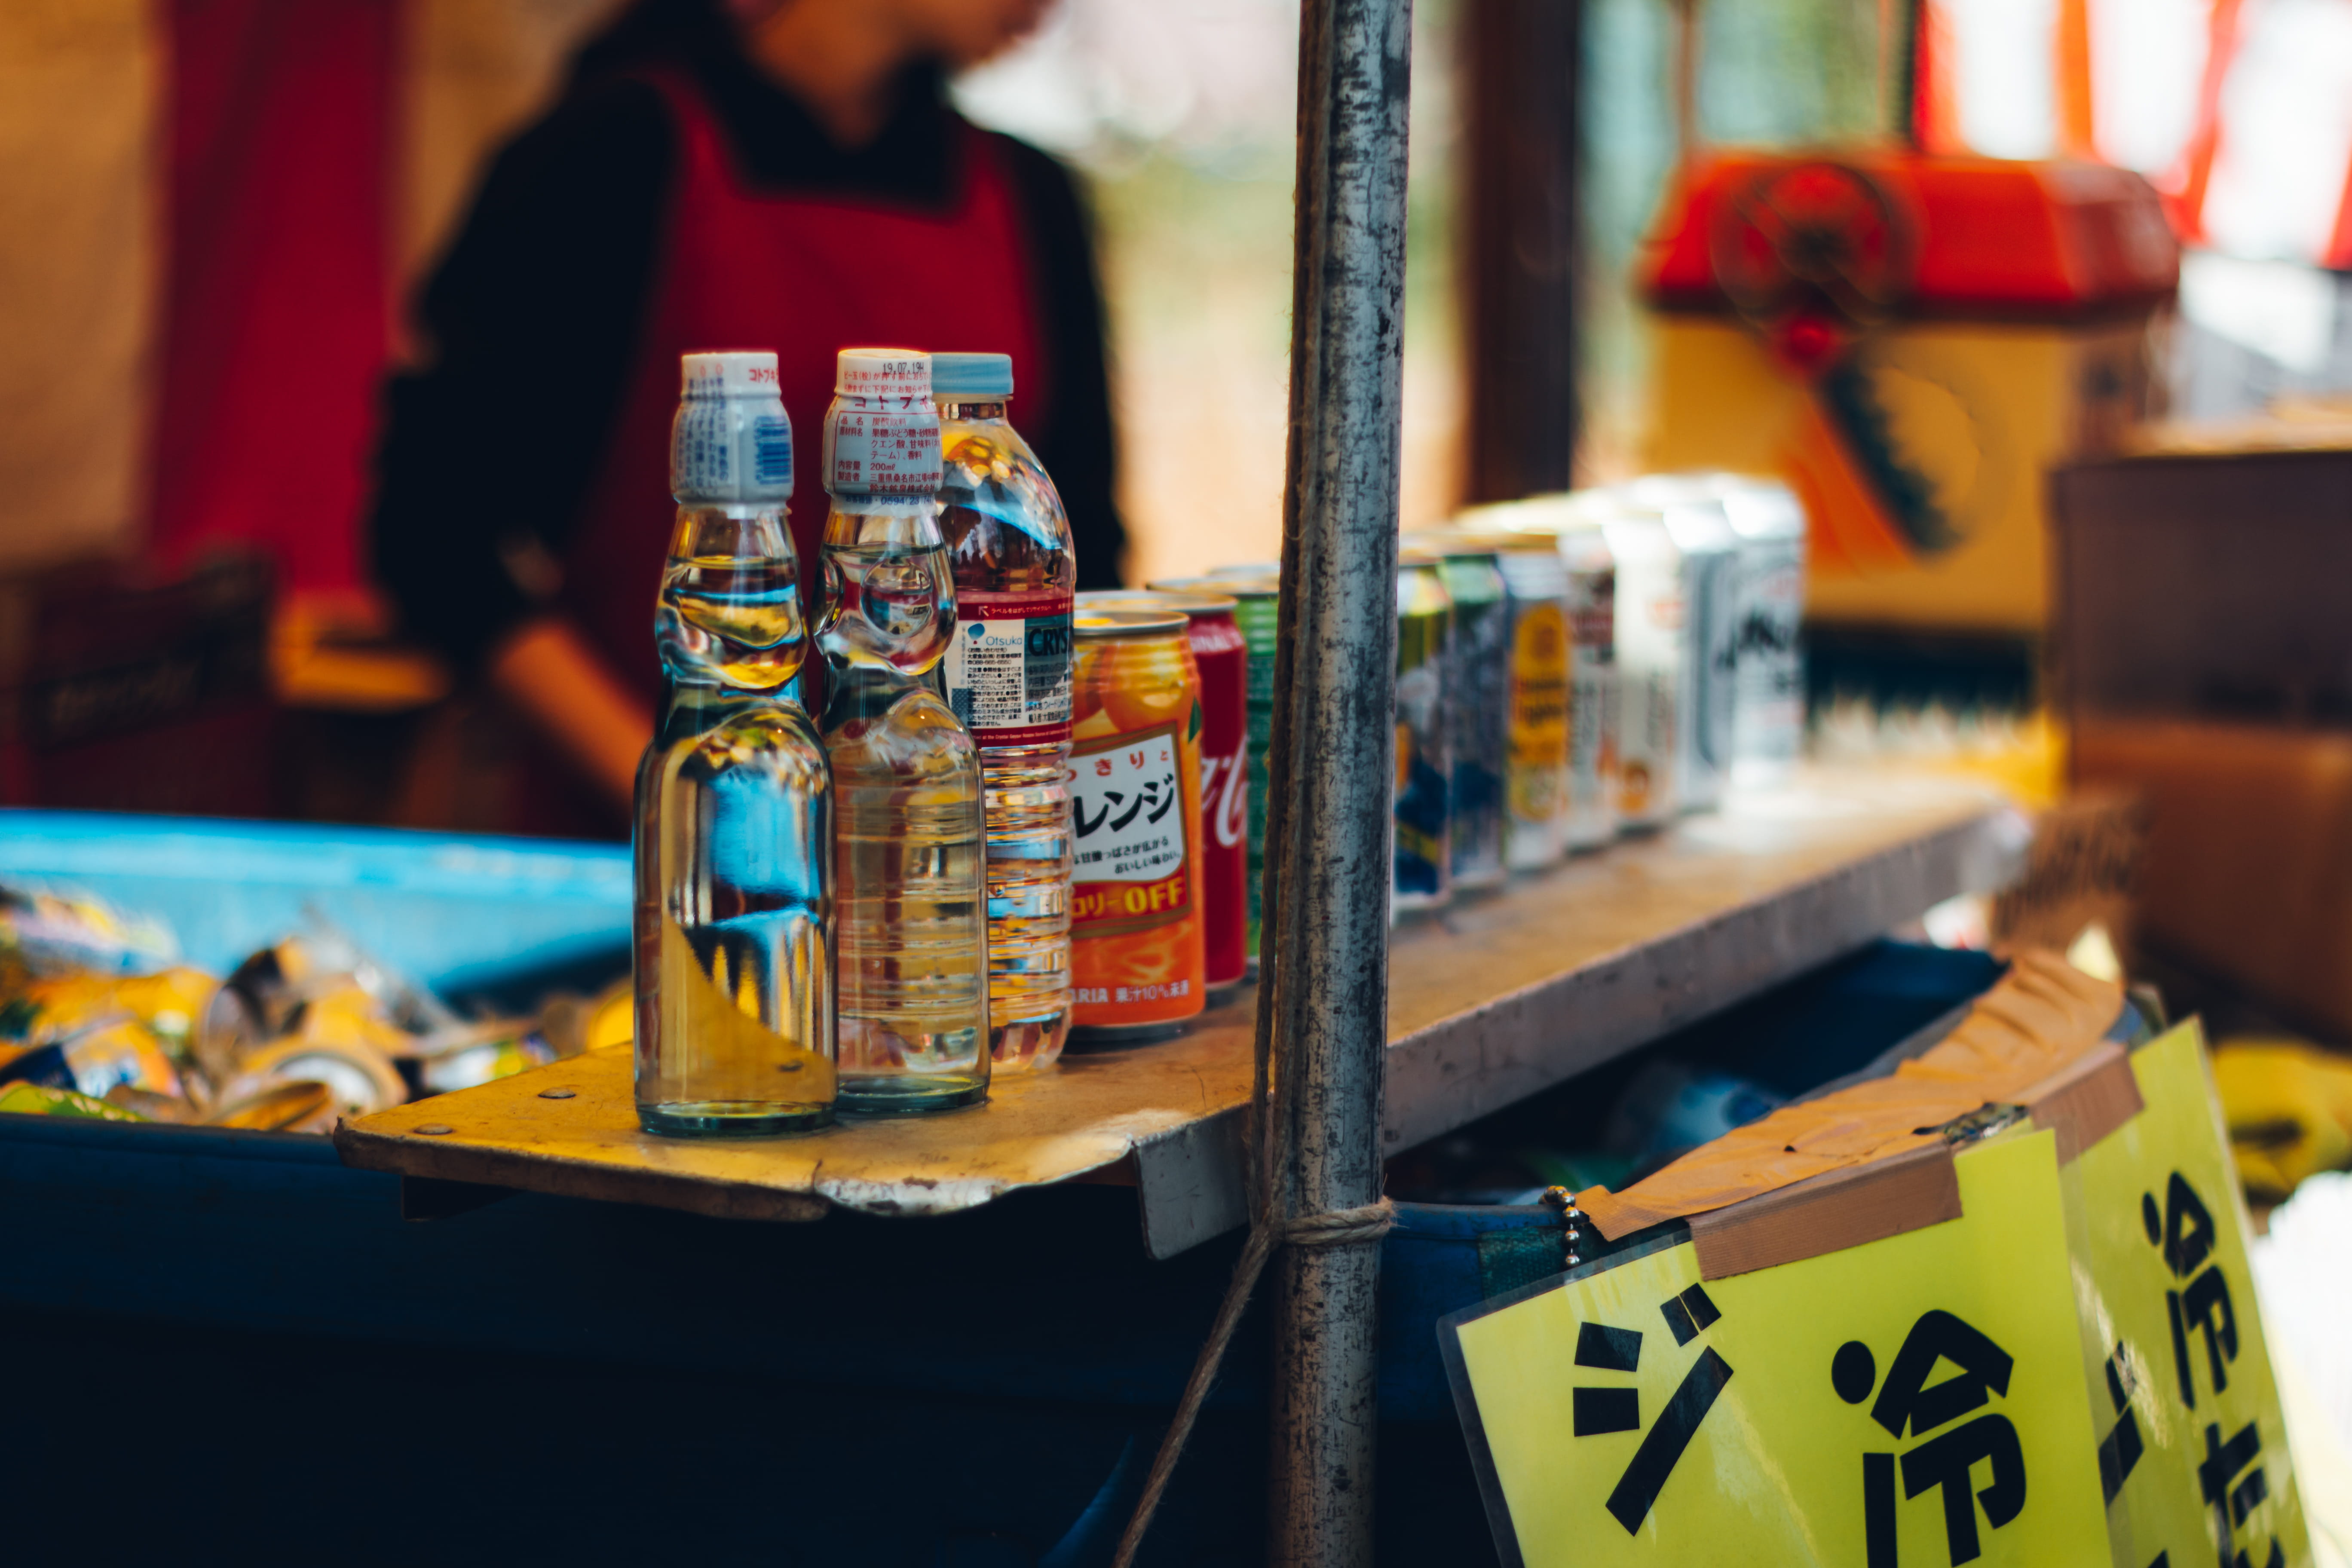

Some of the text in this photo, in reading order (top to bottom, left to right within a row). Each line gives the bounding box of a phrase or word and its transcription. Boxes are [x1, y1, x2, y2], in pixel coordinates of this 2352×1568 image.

[749, 368, 779, 383] コトブキ
[873, 417, 906, 426] 炭酸飲料
[840, 427, 863, 437] 原材料名
[838, 460, 861, 471] 内容量
[838, 472, 860, 481] 製造者
[986, 636, 1022, 645] Otsuka
[1831, 1309, 2026, 1568] 冷
